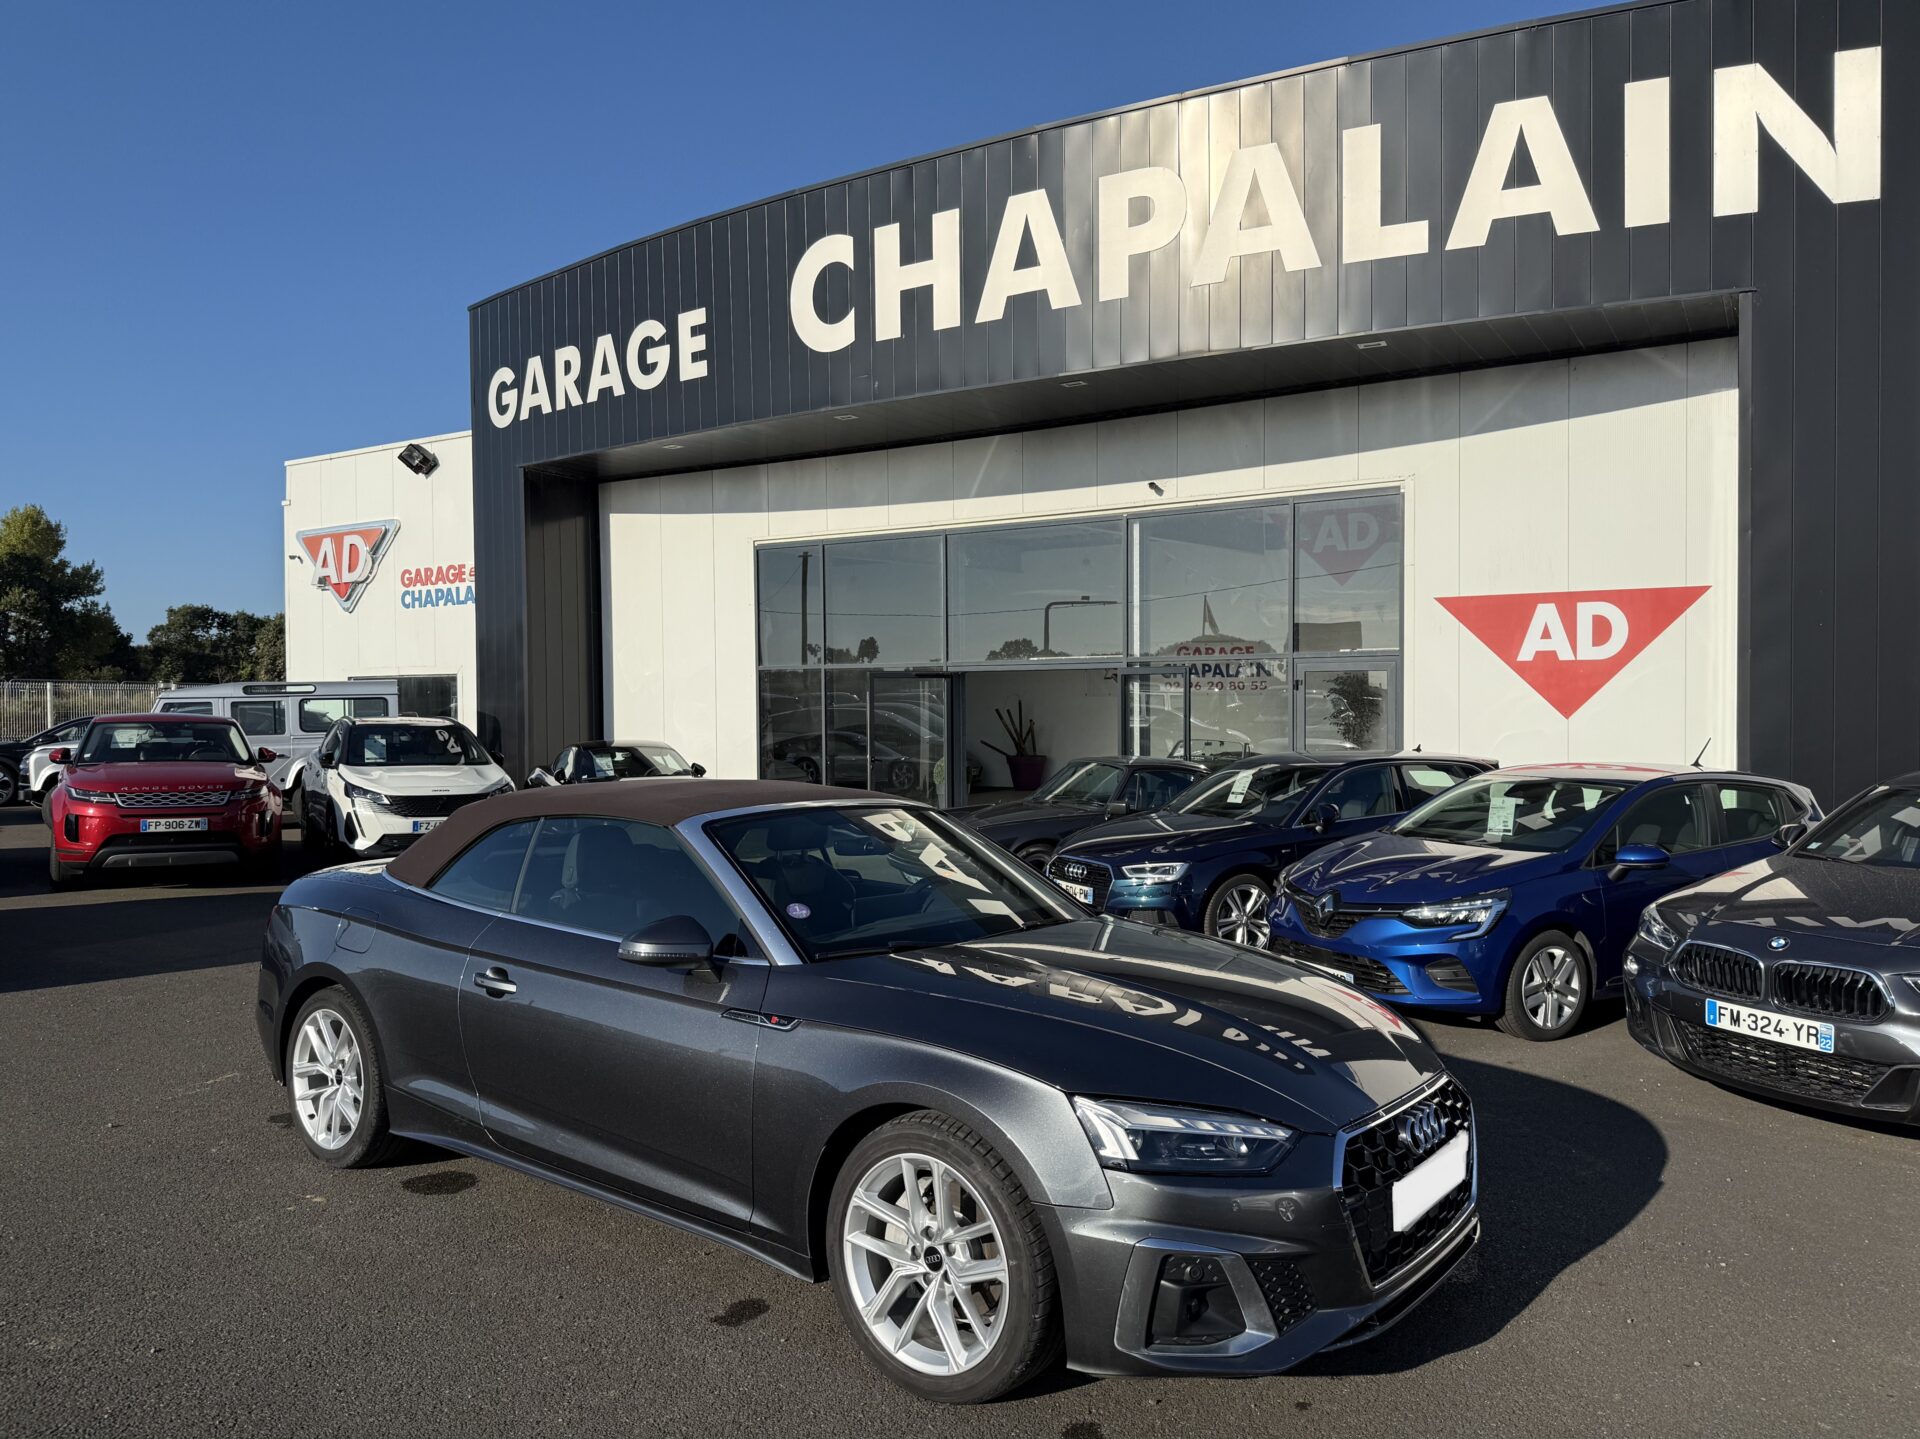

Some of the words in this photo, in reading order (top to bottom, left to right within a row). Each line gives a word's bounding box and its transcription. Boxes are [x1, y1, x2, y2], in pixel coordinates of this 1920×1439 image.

[487, 306, 708, 428] GARAGE
[790, 46, 1882, 353] CHAPALAIN
[1313, 512, 1379, 552] AD
[311, 534, 368, 585] AD
[400, 564, 466, 588] GARAGE
[1516, 601, 1629, 661] AD
[1207, 681, 1224, 691] 20
[1229, 681, 1245, 691] 80
[1250, 680, 1268, 691] 55
[147, 819, 200, 830] FP-906-ZW
[1718, 1005, 1819, 1045] FM-324-YR
[1820, 1038, 1832, 1049] 22
